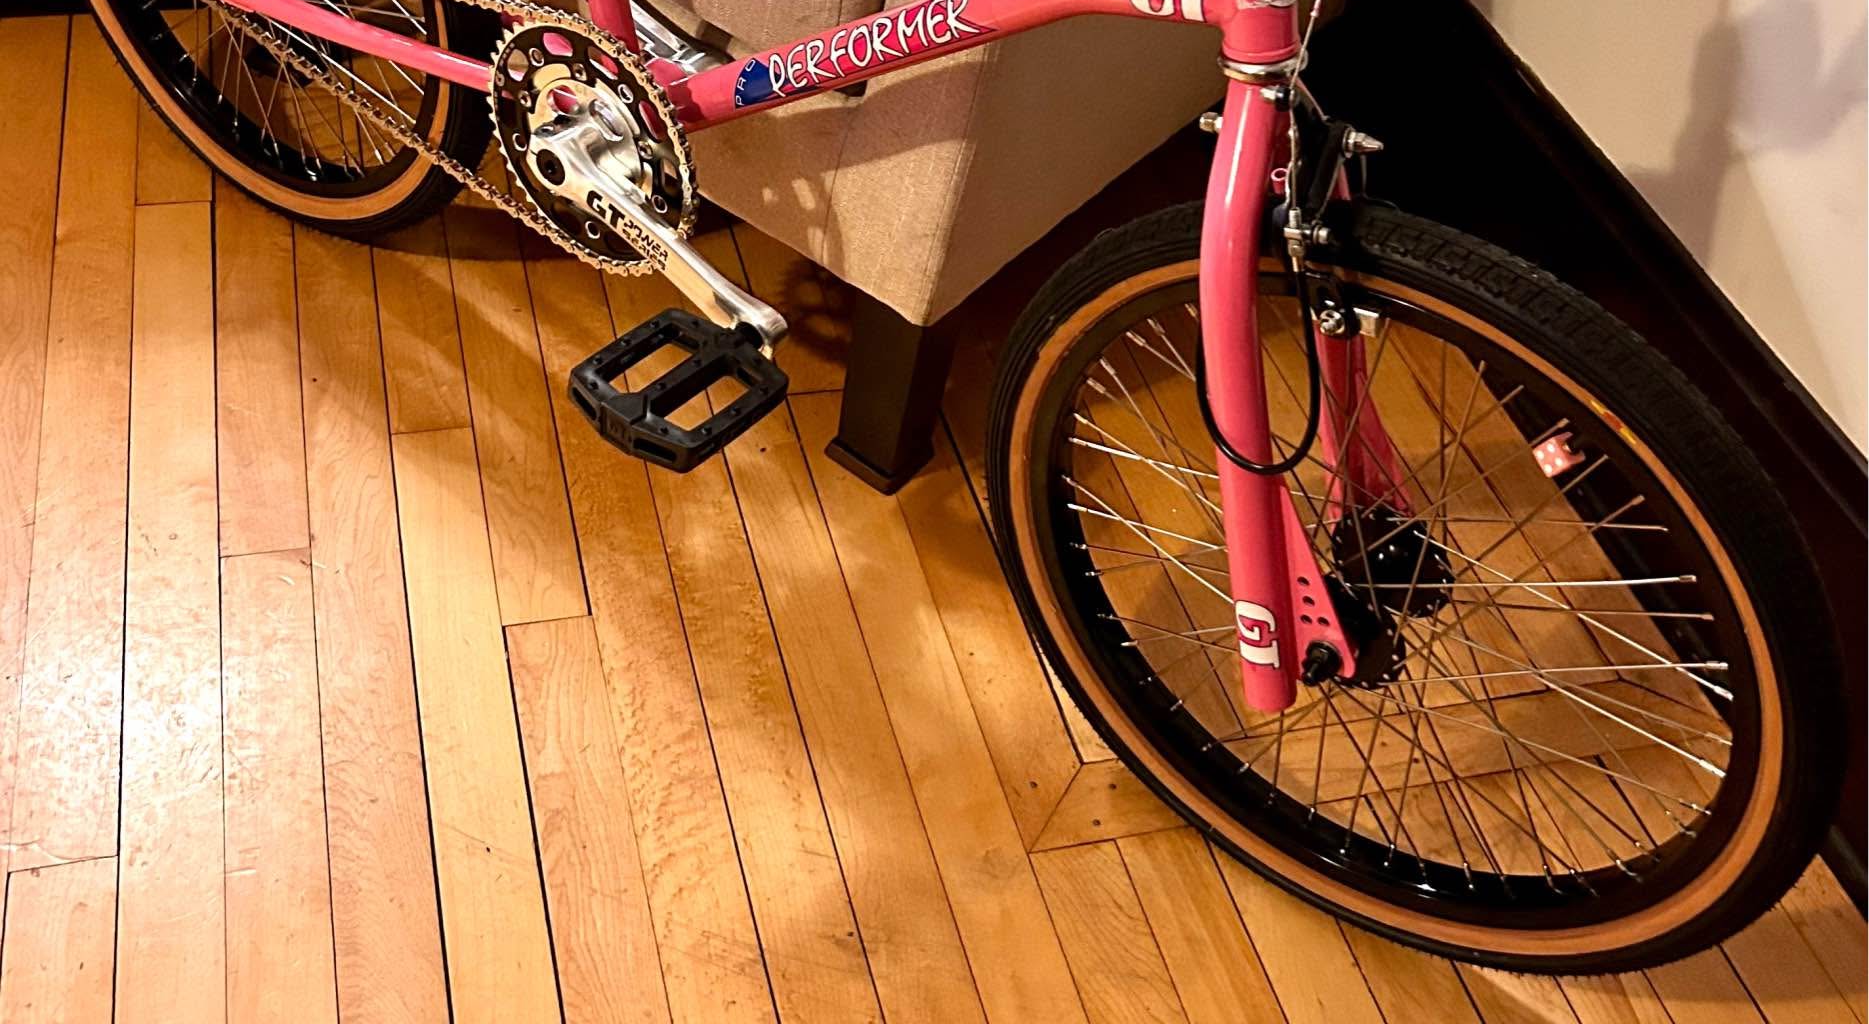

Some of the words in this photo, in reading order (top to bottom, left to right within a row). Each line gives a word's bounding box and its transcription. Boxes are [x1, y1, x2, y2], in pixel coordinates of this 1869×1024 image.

[735, 58, 756, 106] PRO
[586, 190, 626, 229] GT
[623, 220, 669, 261] POWER
[1235, 600, 1280, 669] GT
